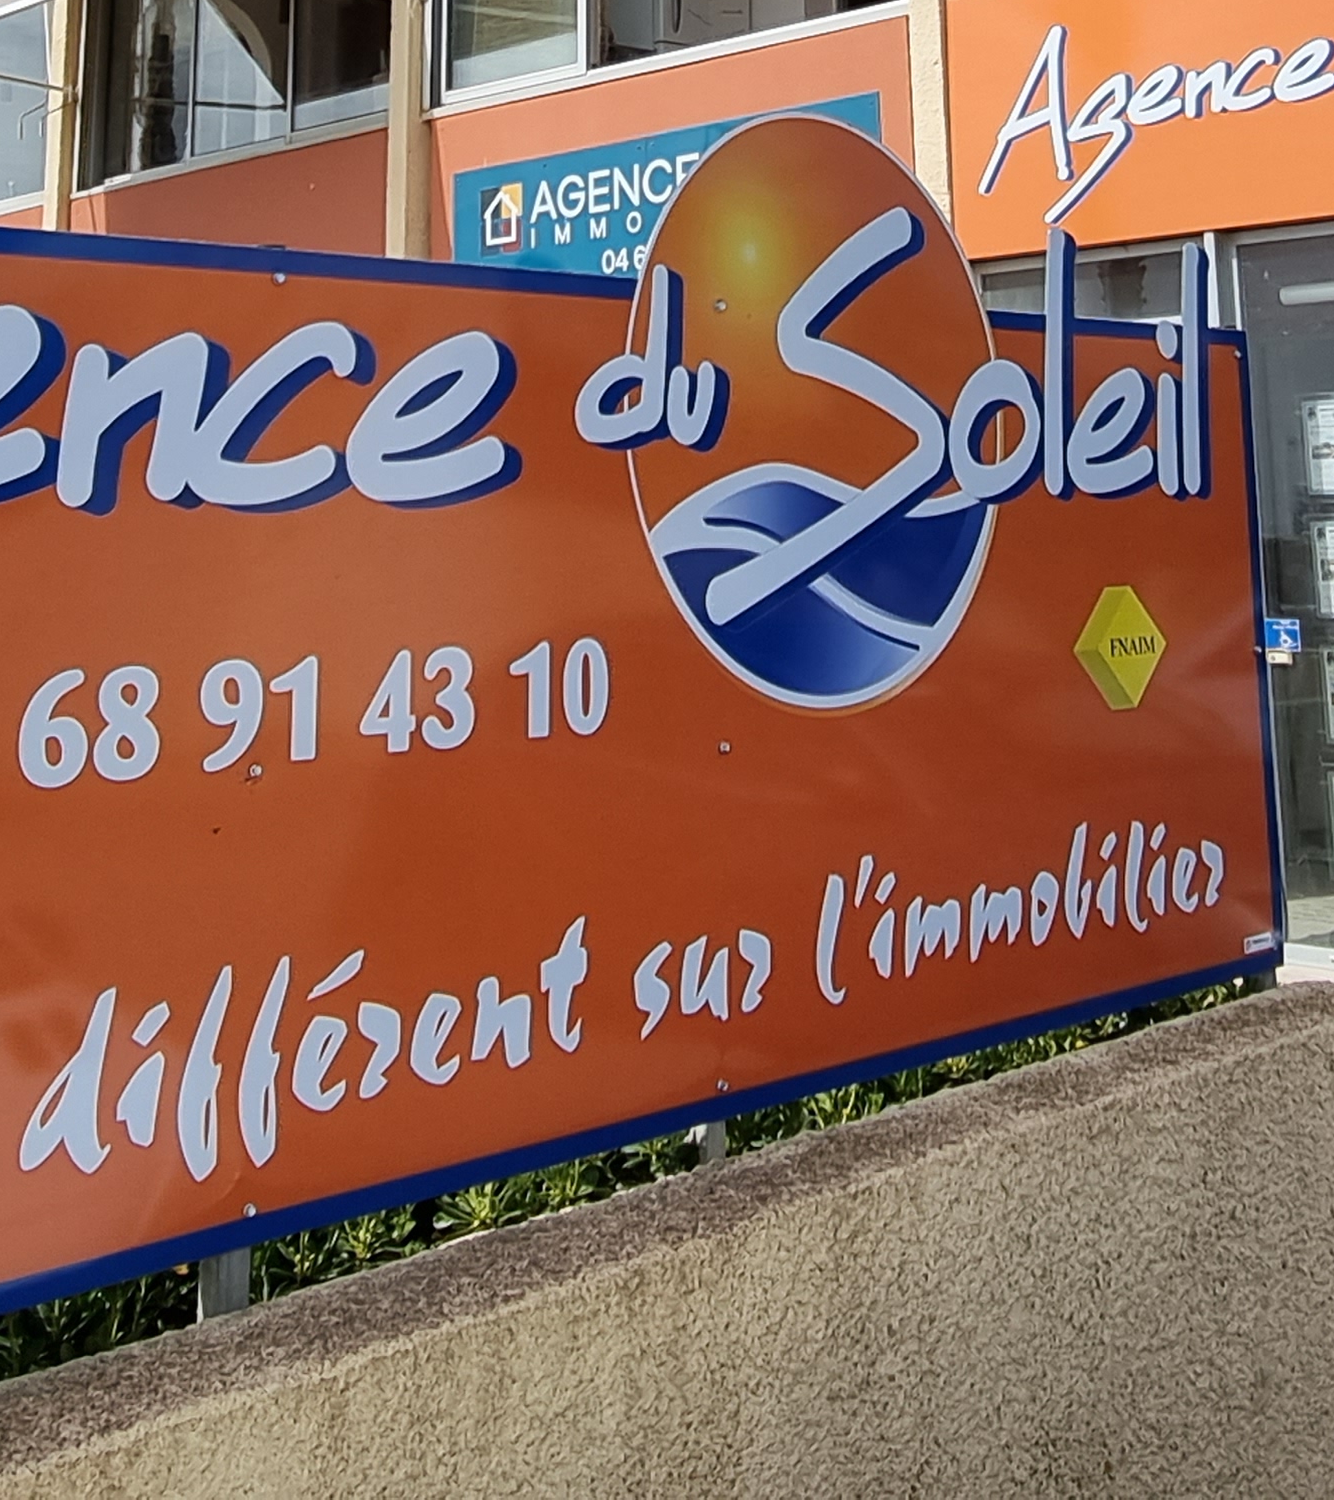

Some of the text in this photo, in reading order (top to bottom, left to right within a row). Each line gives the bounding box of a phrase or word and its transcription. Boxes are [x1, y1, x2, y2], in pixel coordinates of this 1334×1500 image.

[575, 265, 729, 452] du
[705, 207, 1208, 626] Soleil
[17, 665, 161, 788] 68
[199, 653, 320, 773] 91
[358, 645, 476, 754] 43
[508, 637, 609, 739] 10
[1110, 634, 1156, 658] FNAIM
[19, 914, 588, 1183] différent
[633, 928, 771, 1040] sur
[815, 820, 1224, 1005] l'immobilier
